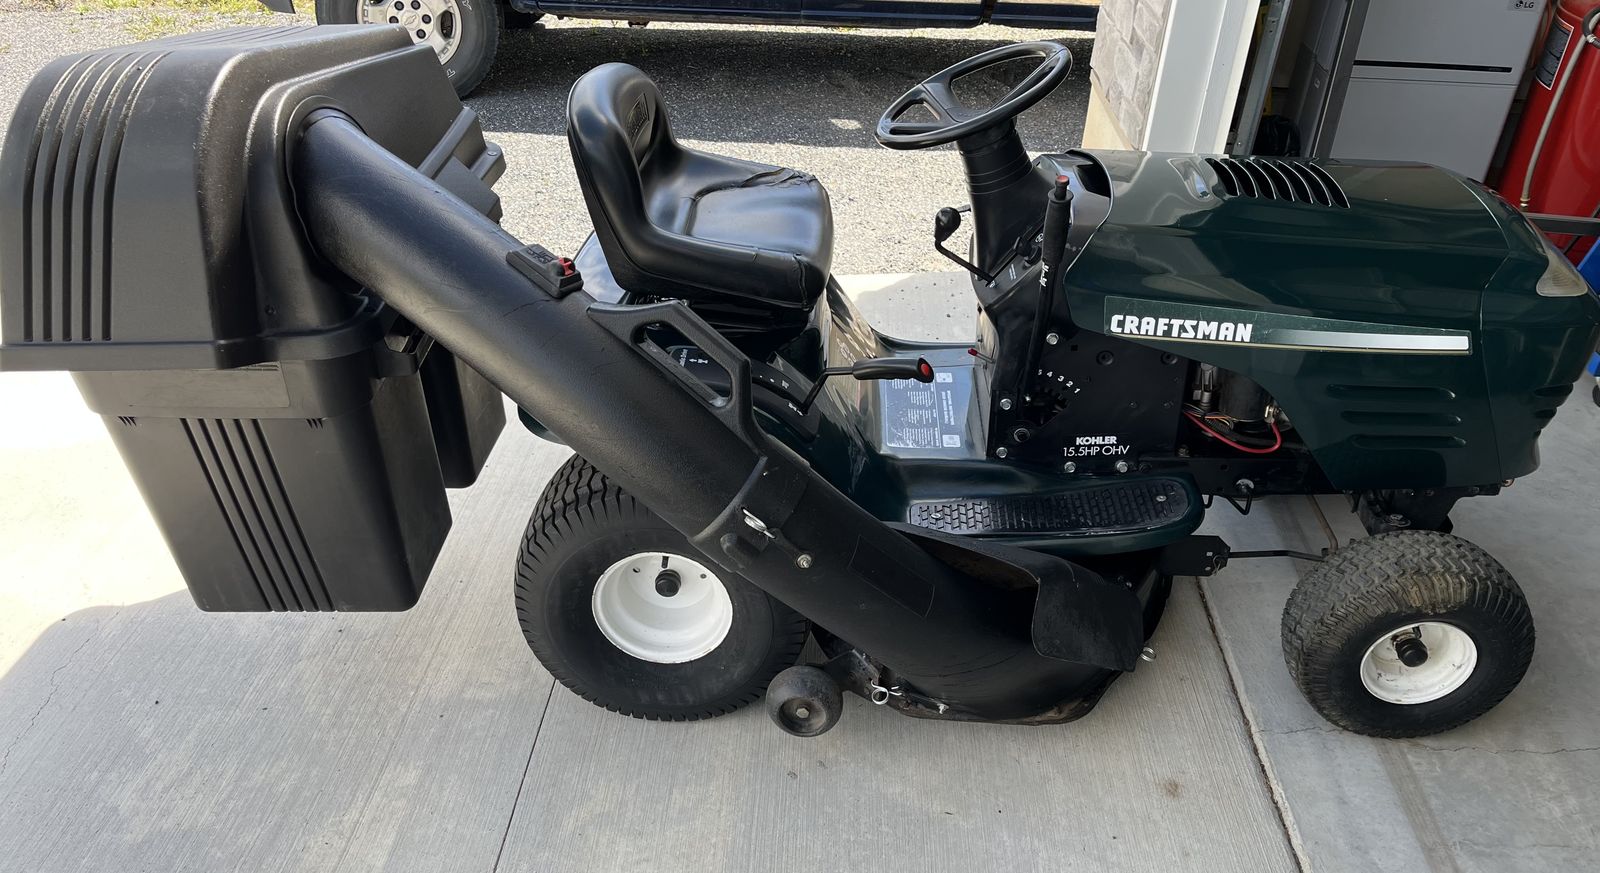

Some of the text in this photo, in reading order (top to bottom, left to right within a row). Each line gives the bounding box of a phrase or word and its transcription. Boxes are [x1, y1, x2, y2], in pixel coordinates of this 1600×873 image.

[1110, 314, 1253, 343] CRAFTSMAN
[1066, 380, 1073, 388] 2
[1075, 435, 1118, 446] KOHLER
[1063, 444, 1130, 457] 15.5HP OHV
